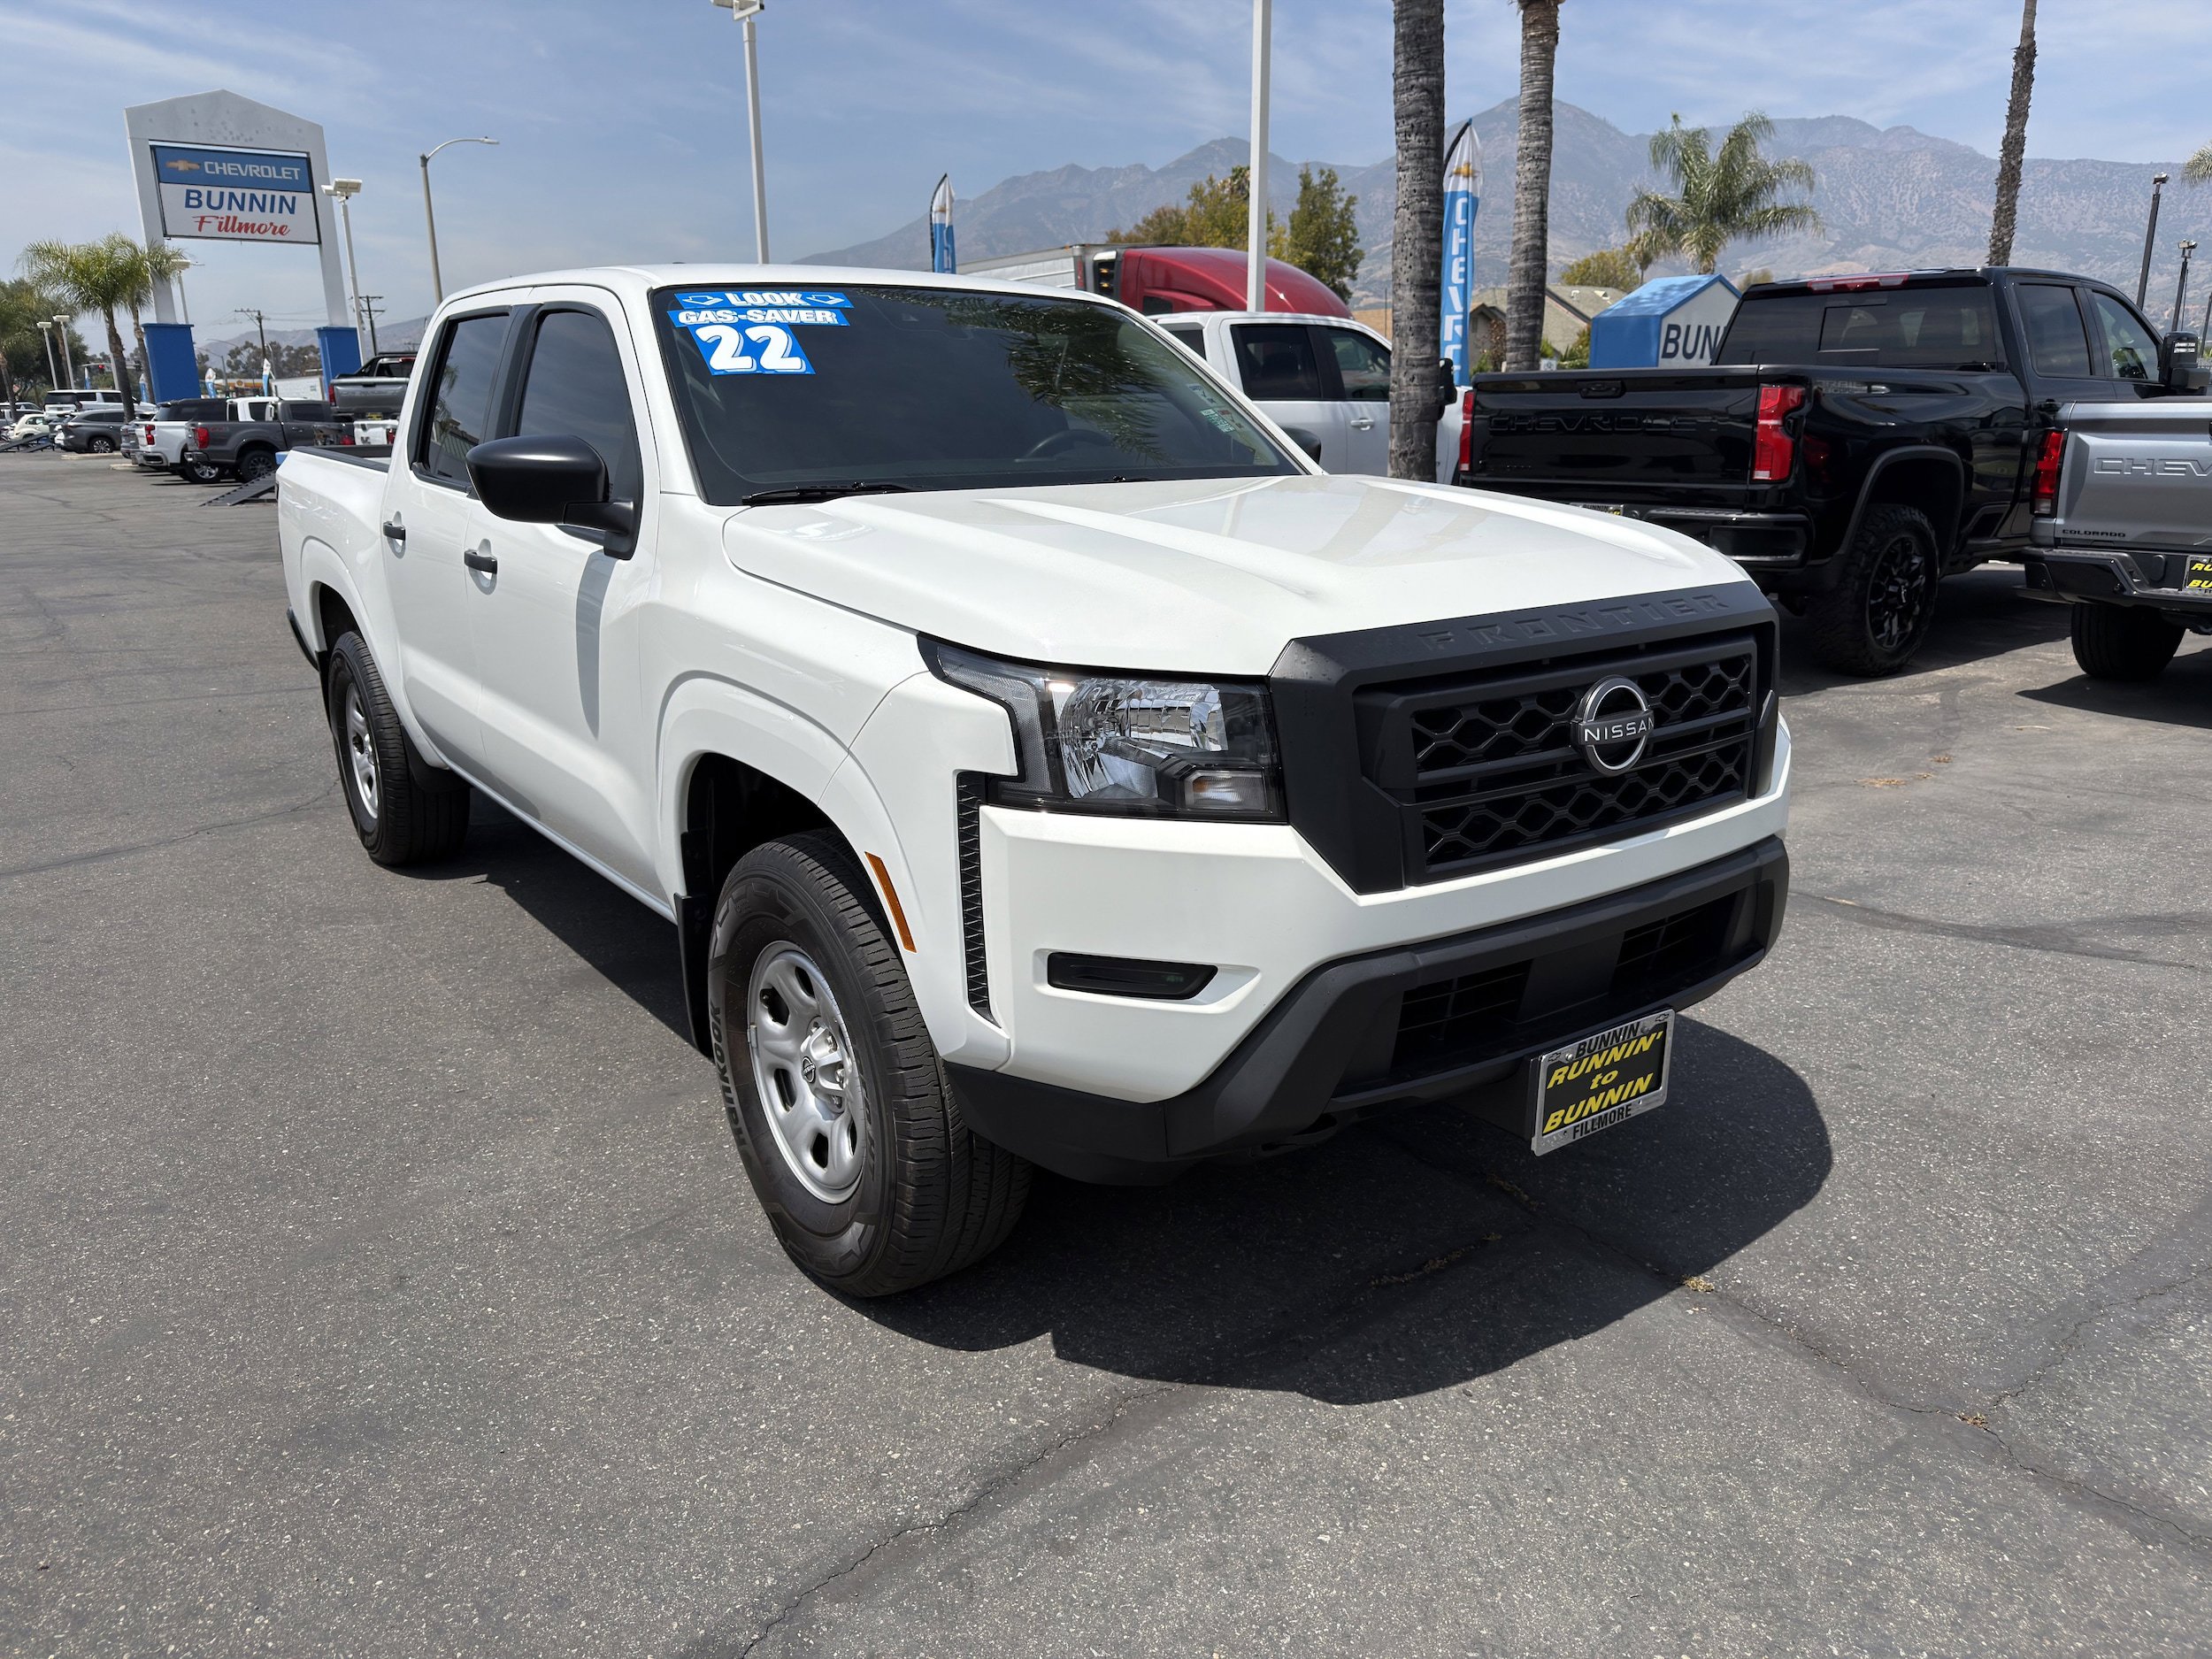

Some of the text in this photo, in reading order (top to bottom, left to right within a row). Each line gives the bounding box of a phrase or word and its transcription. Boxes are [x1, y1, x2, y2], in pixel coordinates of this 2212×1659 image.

[204, 161, 301, 180] CHEVROLET
[184, 188, 297, 215] BUNNIN
[192, 215, 291, 236] Fillmore
[725, 292, 810, 307] LOOK
[678, 310, 840, 325] GAS-SAVER
[695, 325, 807, 373] 22
[1661, 324, 1727, 360] BUN
[2062, 529, 2126, 538] COLORADO
[1417, 594, 1730, 651] FRONTIER
[1584, 717, 1654, 741] NISSAN
[1575, 1022, 1642, 1058] BUNNIN
[1547, 1031, 1663, 1090] RUNNIN'
[1589, 1070, 1618, 1090] to
[1542, 1073, 1654, 1134] BUNNIN
[1572, 1103, 1632, 1140] FILLMORE
